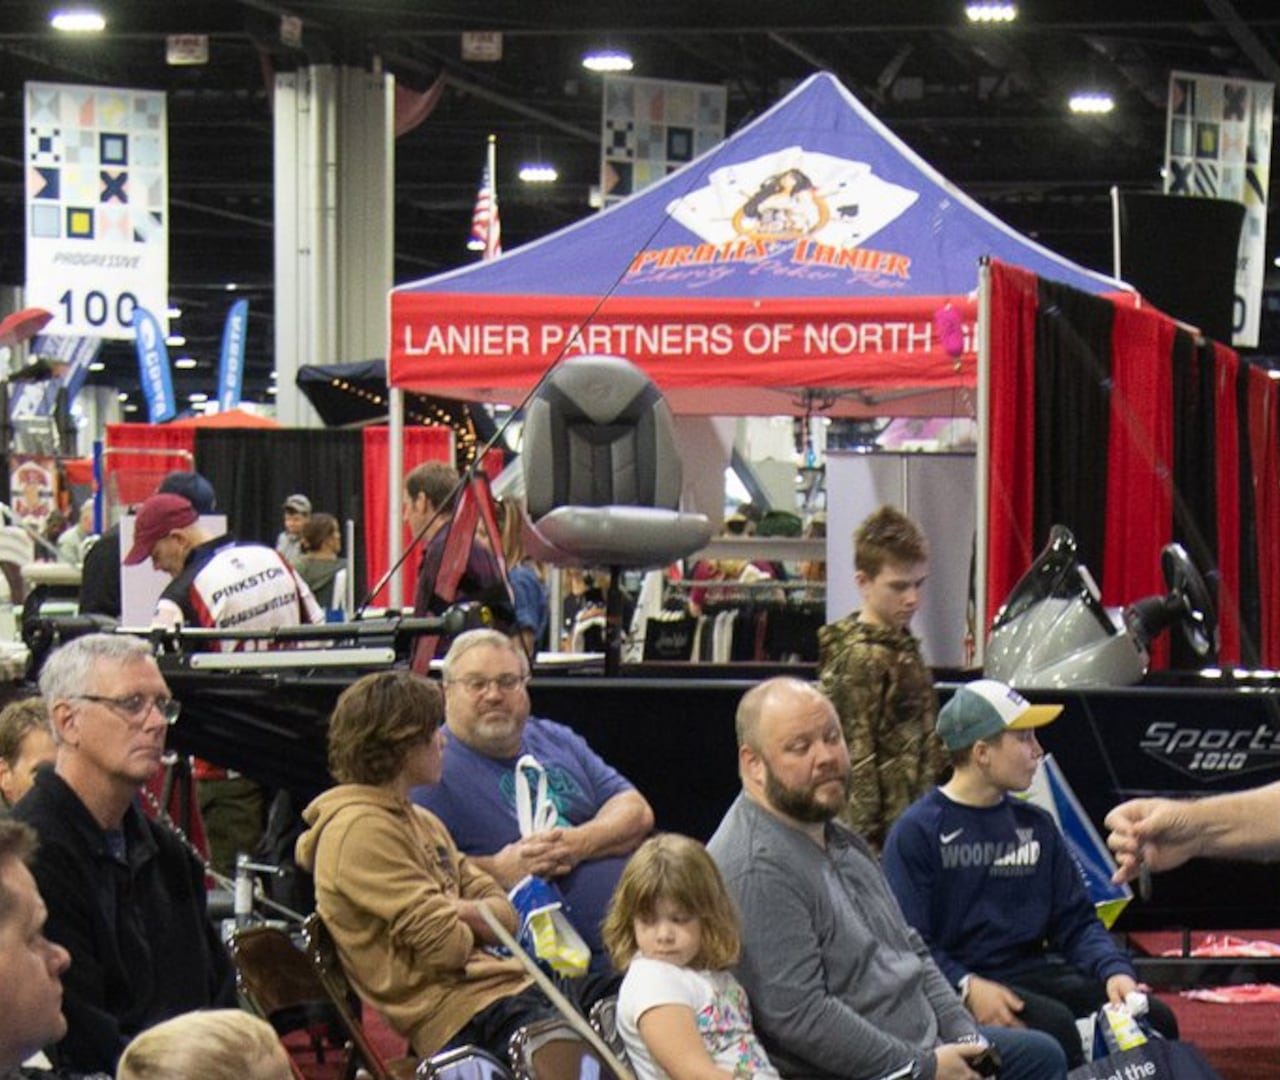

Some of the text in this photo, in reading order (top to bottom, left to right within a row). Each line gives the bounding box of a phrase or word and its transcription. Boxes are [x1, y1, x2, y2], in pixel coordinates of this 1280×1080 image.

[59, 288, 139, 328] 100
[404, 324, 530, 356] LANIER
[541, 323, 733, 355] PARTNERS
[743, 323, 793, 353] OF
[804, 322, 932, 353] NORTH
[940, 839, 1041, 869] WOODLAND
